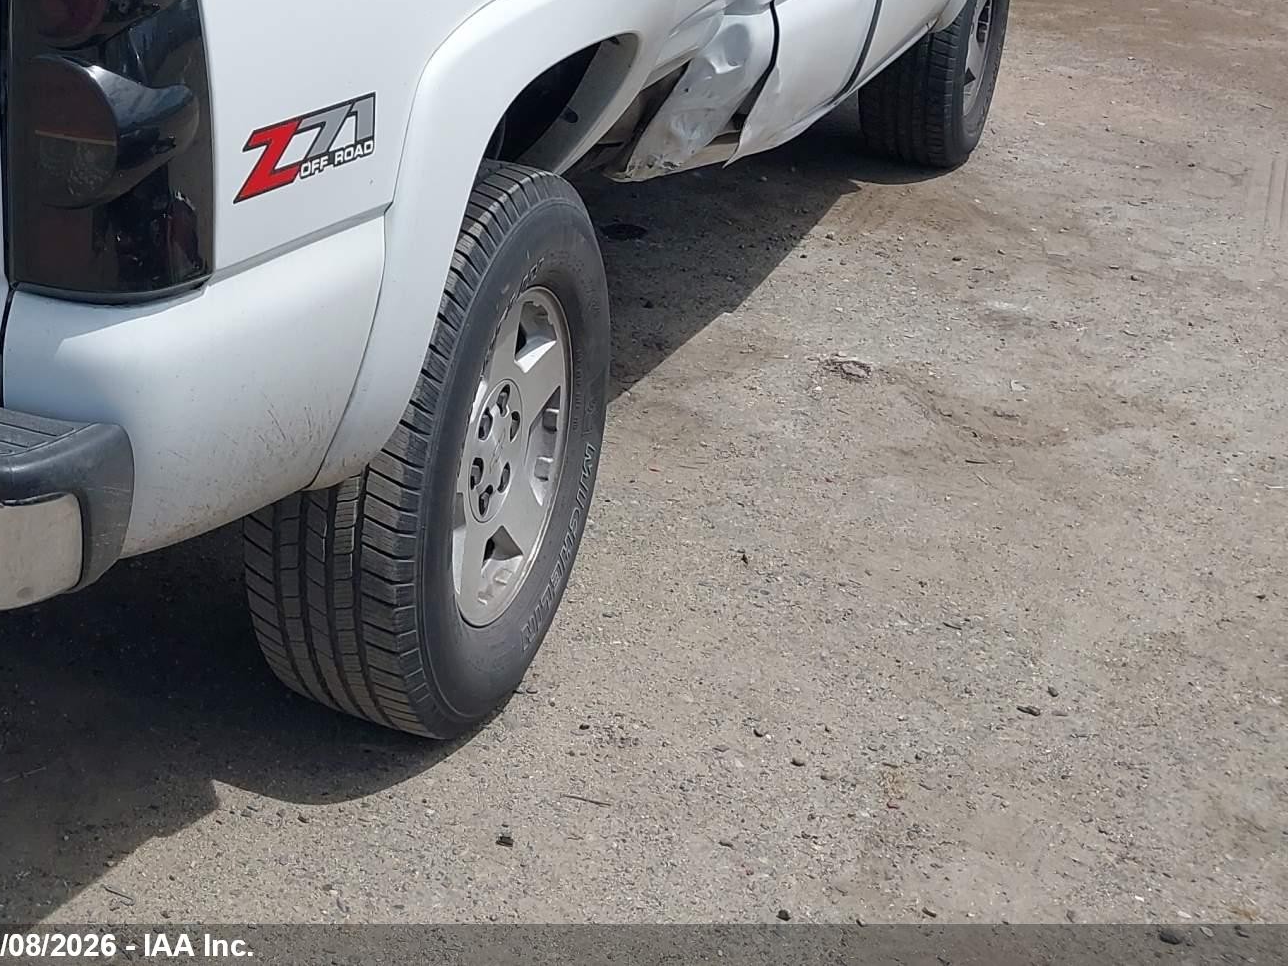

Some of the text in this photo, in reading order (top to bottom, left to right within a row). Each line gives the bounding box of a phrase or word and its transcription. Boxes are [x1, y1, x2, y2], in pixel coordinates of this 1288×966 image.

[233, 92, 376, 204] Z71
[300, 139, 375, 178] OFF ROAD
[520, 442, 596, 652] MICHELIN
